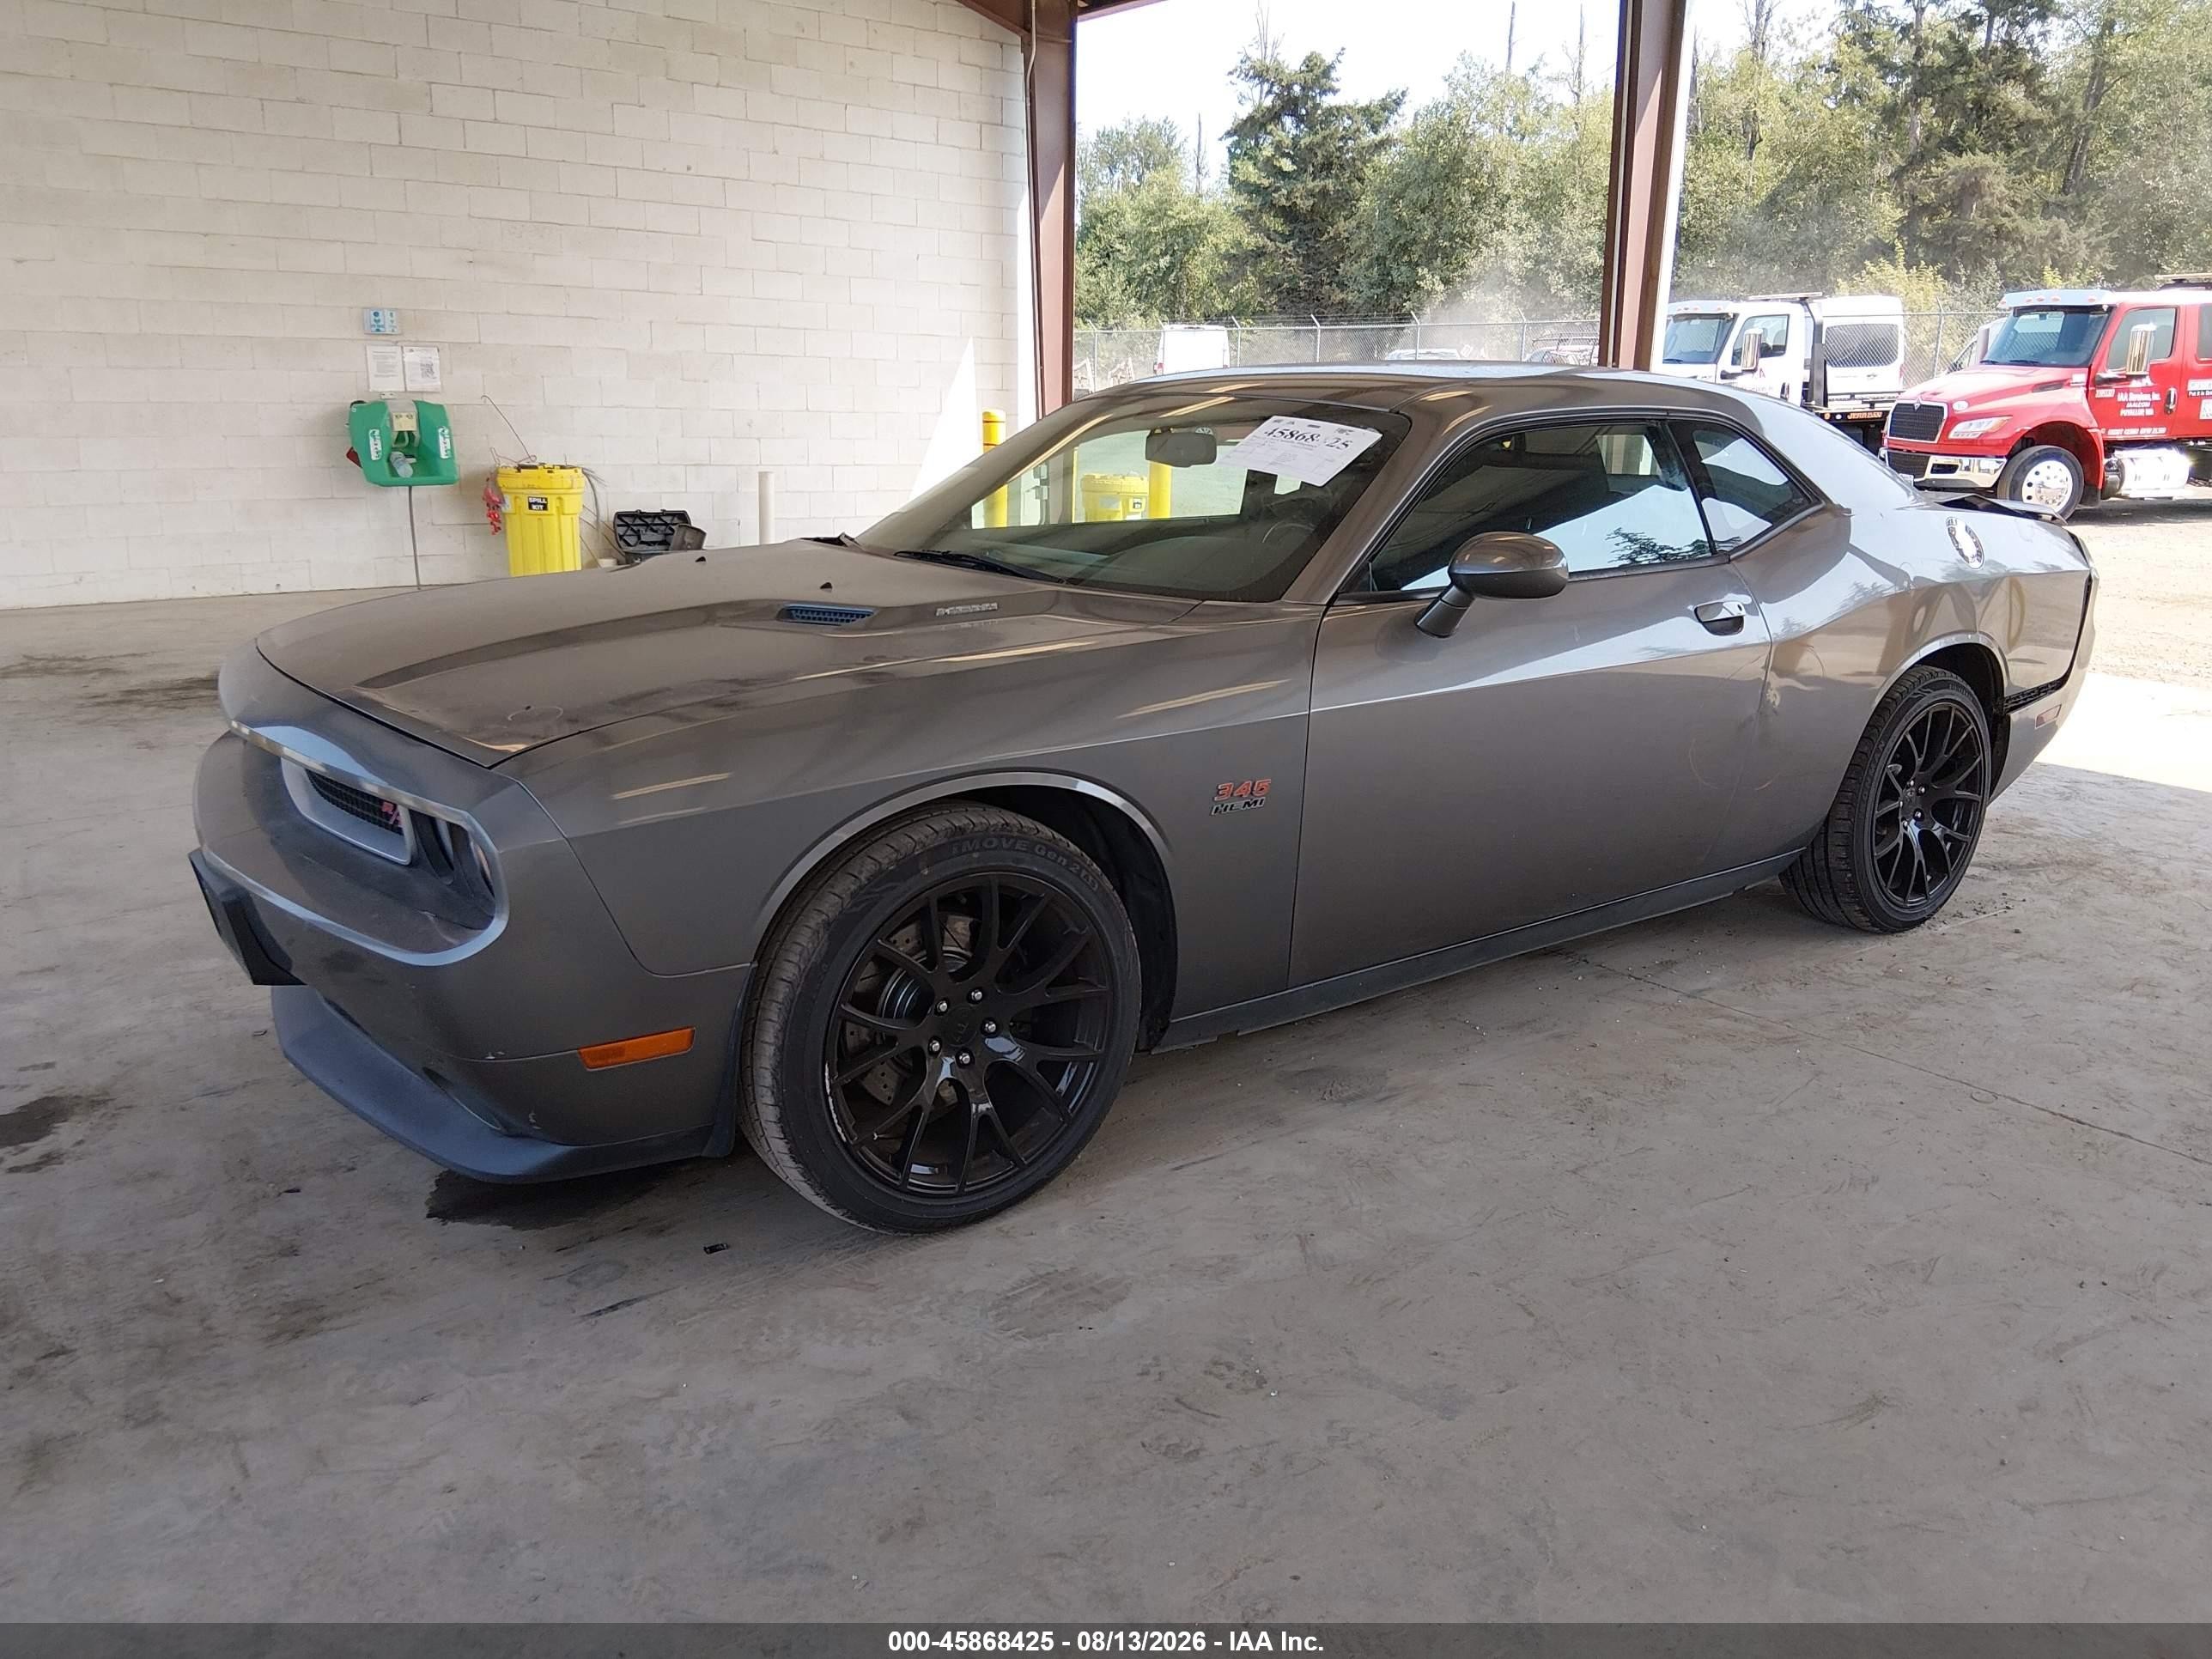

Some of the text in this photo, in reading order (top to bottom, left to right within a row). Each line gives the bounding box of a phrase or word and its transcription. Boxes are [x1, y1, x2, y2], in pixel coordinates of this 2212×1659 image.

[1214, 779, 1272, 801] 345
[1211, 796, 1266, 815] HEMI
[1035, 844, 1067, 866] Gen
